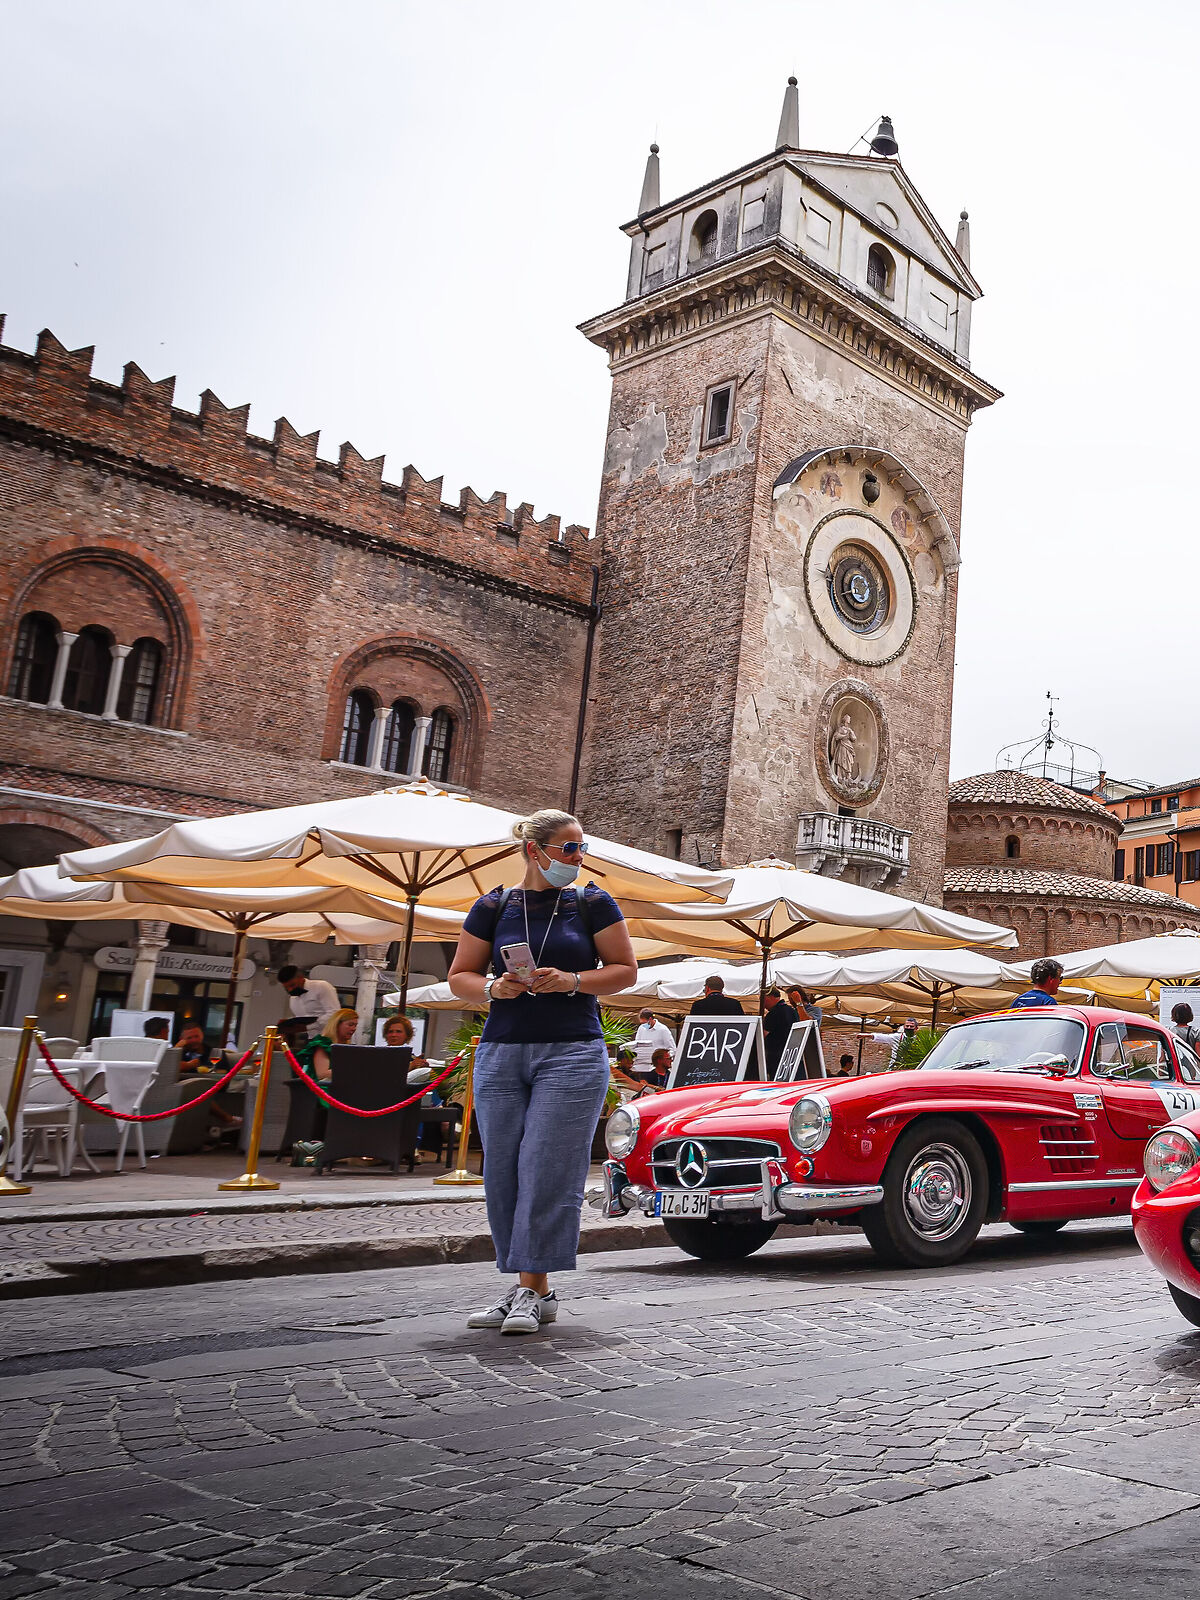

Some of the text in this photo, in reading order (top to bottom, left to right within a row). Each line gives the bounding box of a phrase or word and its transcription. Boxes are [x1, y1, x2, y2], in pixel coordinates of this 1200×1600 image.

[180, 958, 235, 974] Ristoran
[686, 1026, 742, 1065] BAR
[1167, 1091, 1196, 1111] 297
[661, 1194, 708, 1214] IZ C 3H
